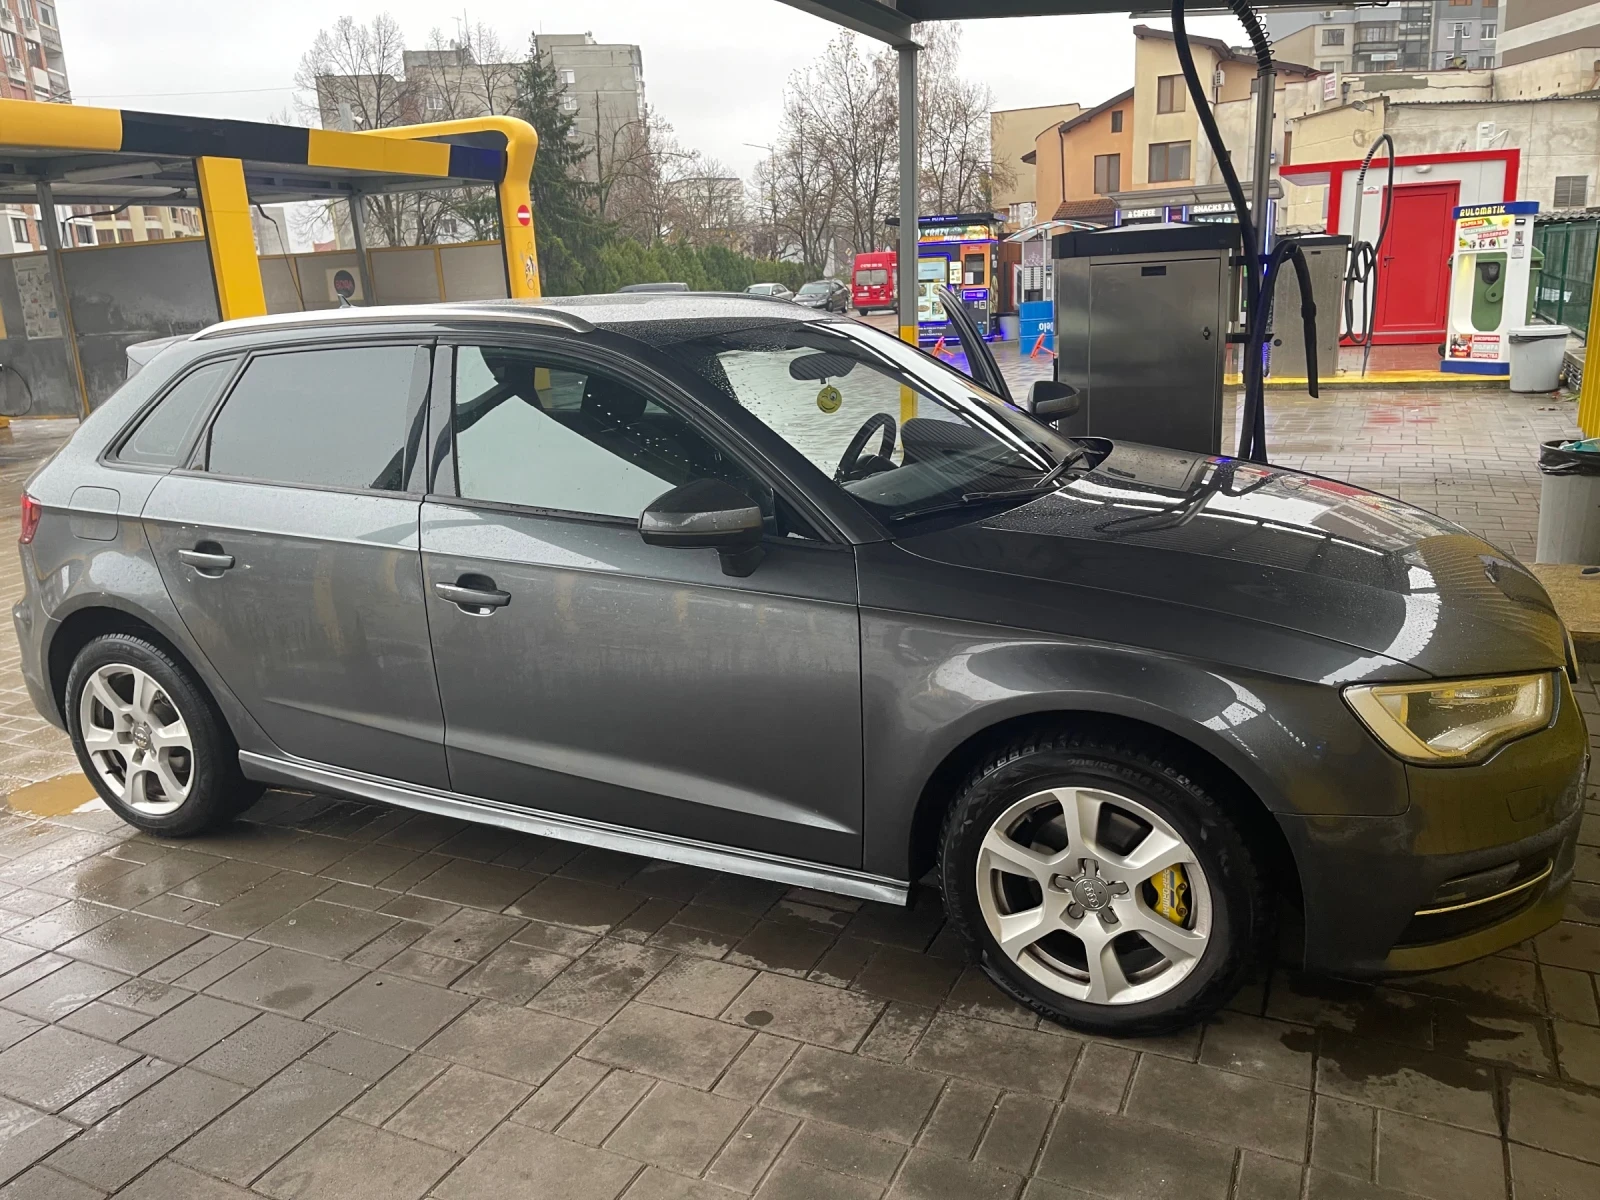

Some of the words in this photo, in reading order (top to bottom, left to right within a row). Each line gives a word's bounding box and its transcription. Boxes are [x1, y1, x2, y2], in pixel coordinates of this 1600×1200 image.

[1193, 203, 1222, 213] SNACKS
[1223, 202, 1230, 211] &
[1460, 206, 1506, 217] RULOMATIK
[1133, 209, 1156, 218] COFFEE
[925, 228, 949, 236] CRAZY
